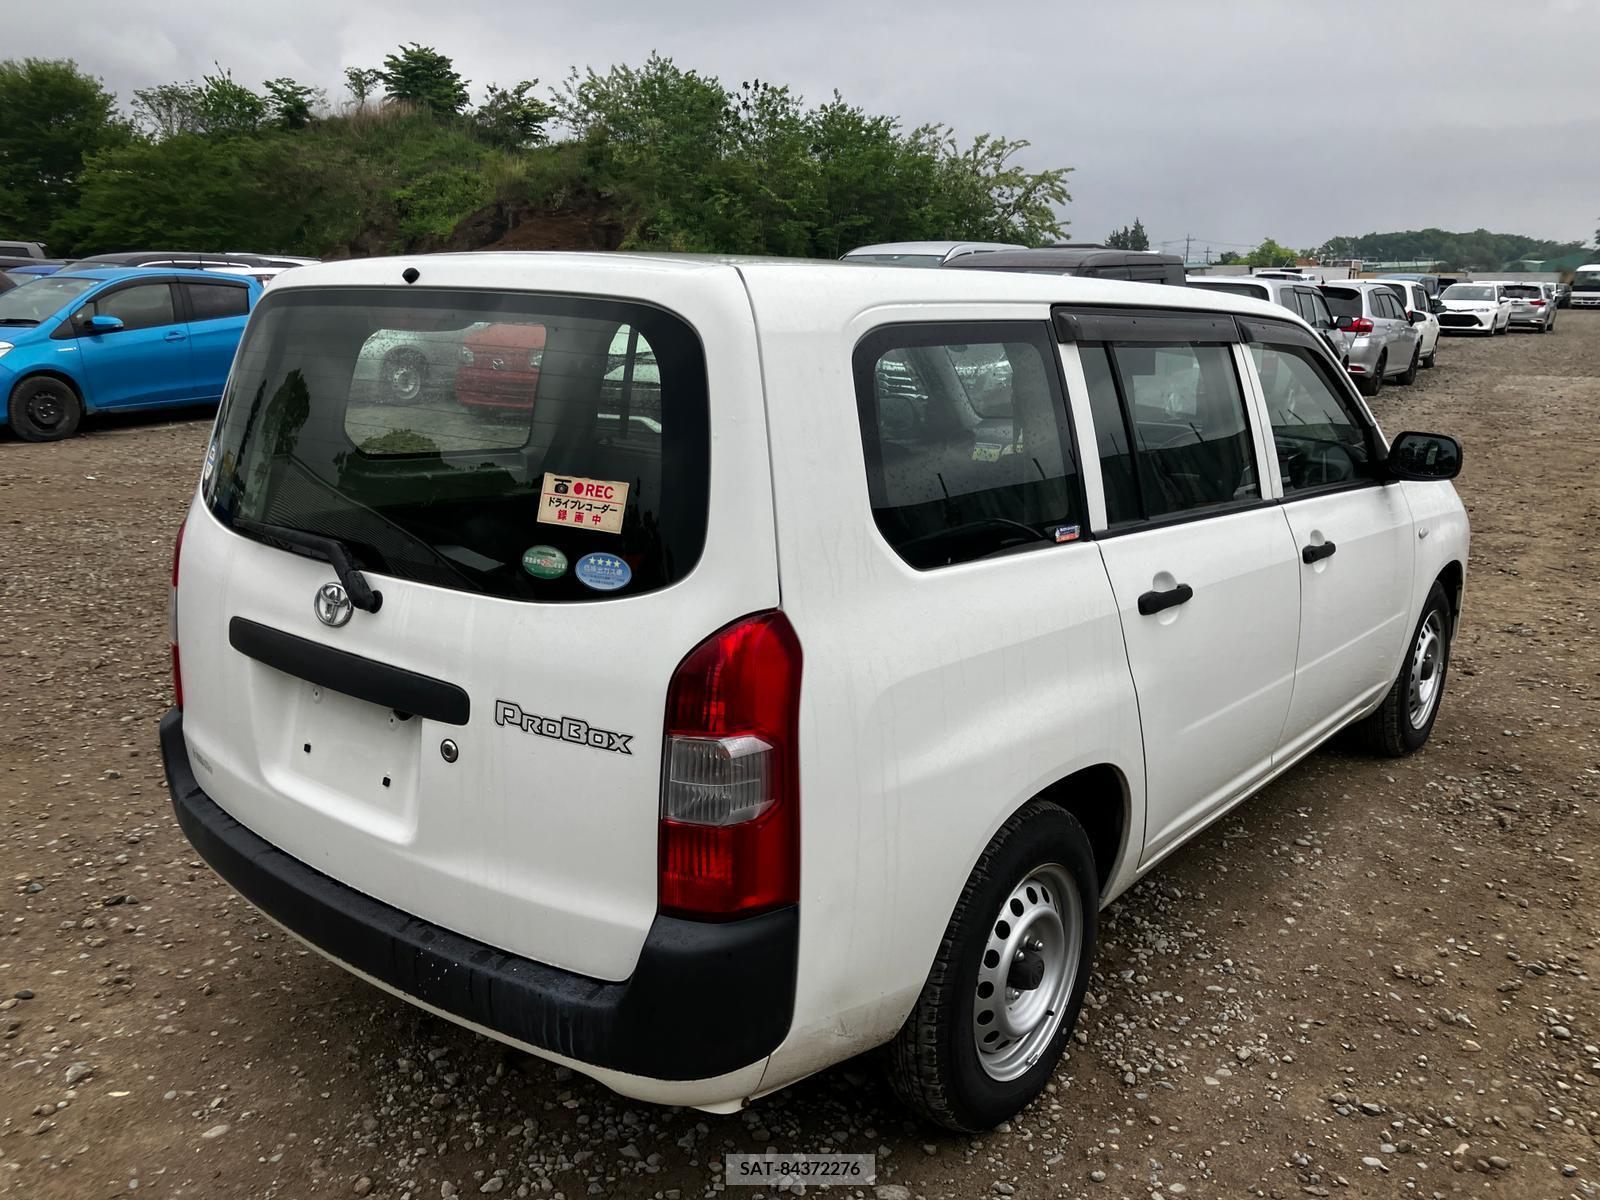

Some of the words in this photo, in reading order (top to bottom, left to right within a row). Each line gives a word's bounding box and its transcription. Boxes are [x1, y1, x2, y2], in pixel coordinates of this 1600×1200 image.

[585, 483, 614, 499] REC
[548, 496, 618, 514] ドライブレコーダー
